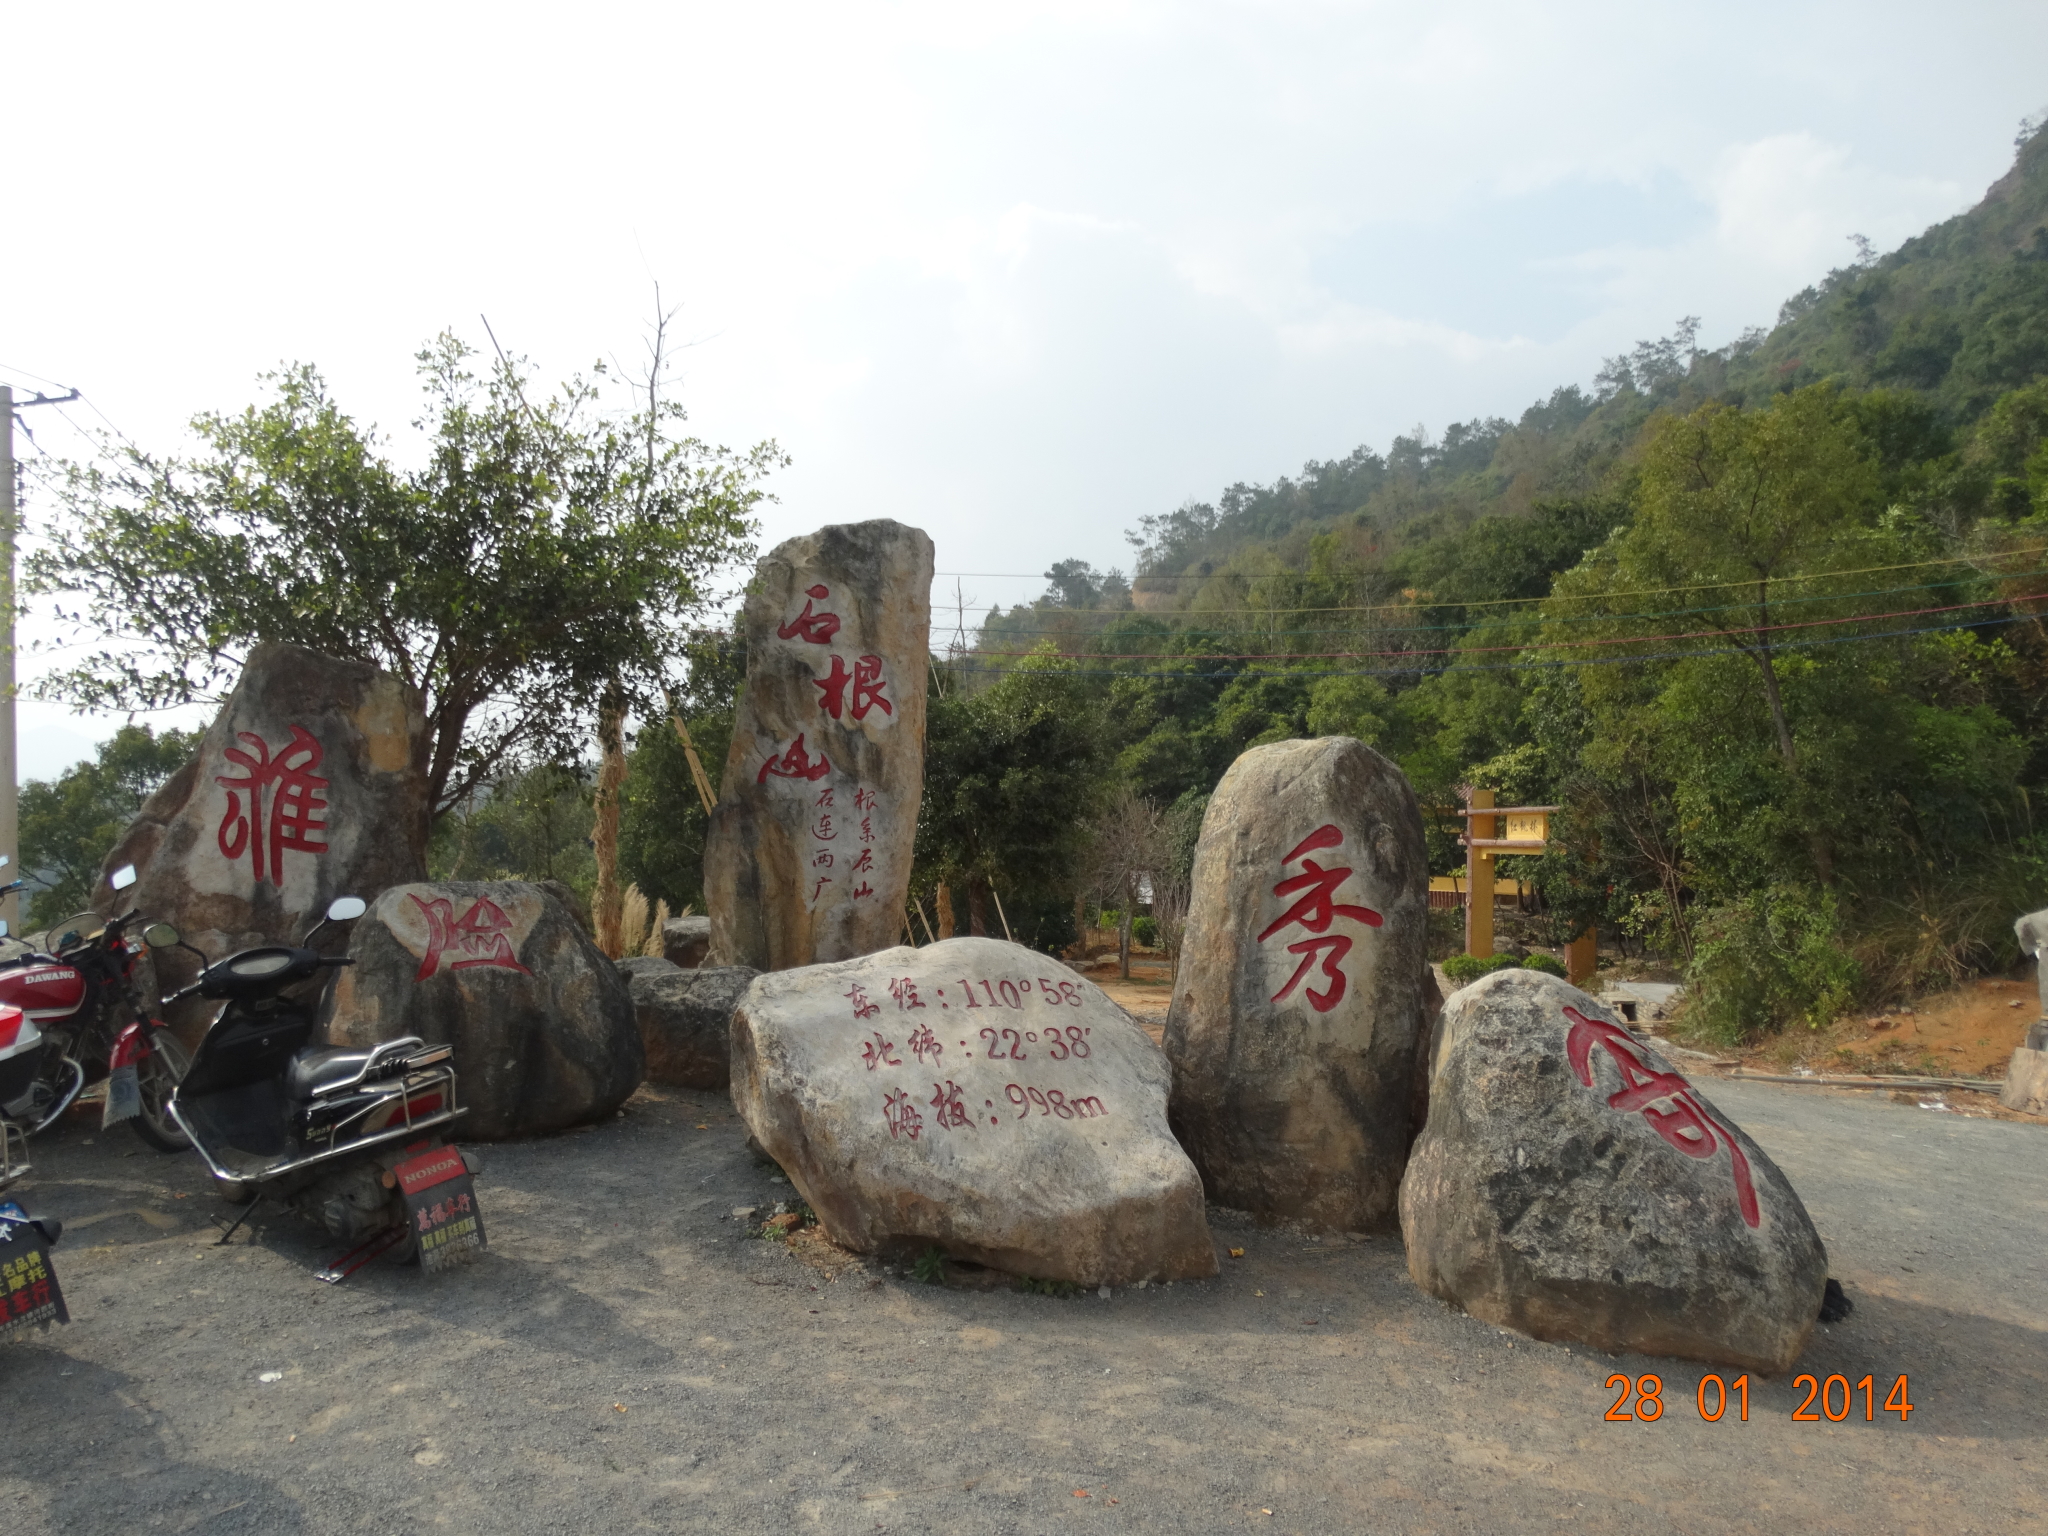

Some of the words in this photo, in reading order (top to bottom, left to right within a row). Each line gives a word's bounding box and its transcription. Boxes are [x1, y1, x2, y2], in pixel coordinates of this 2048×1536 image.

[811, 787, 838, 903] 石连两广
[1257, 824, 1384, 1013] 秀
[24, 971, 75, 985] DAWANG
[0, 1264, 47, 1297] 摩托
